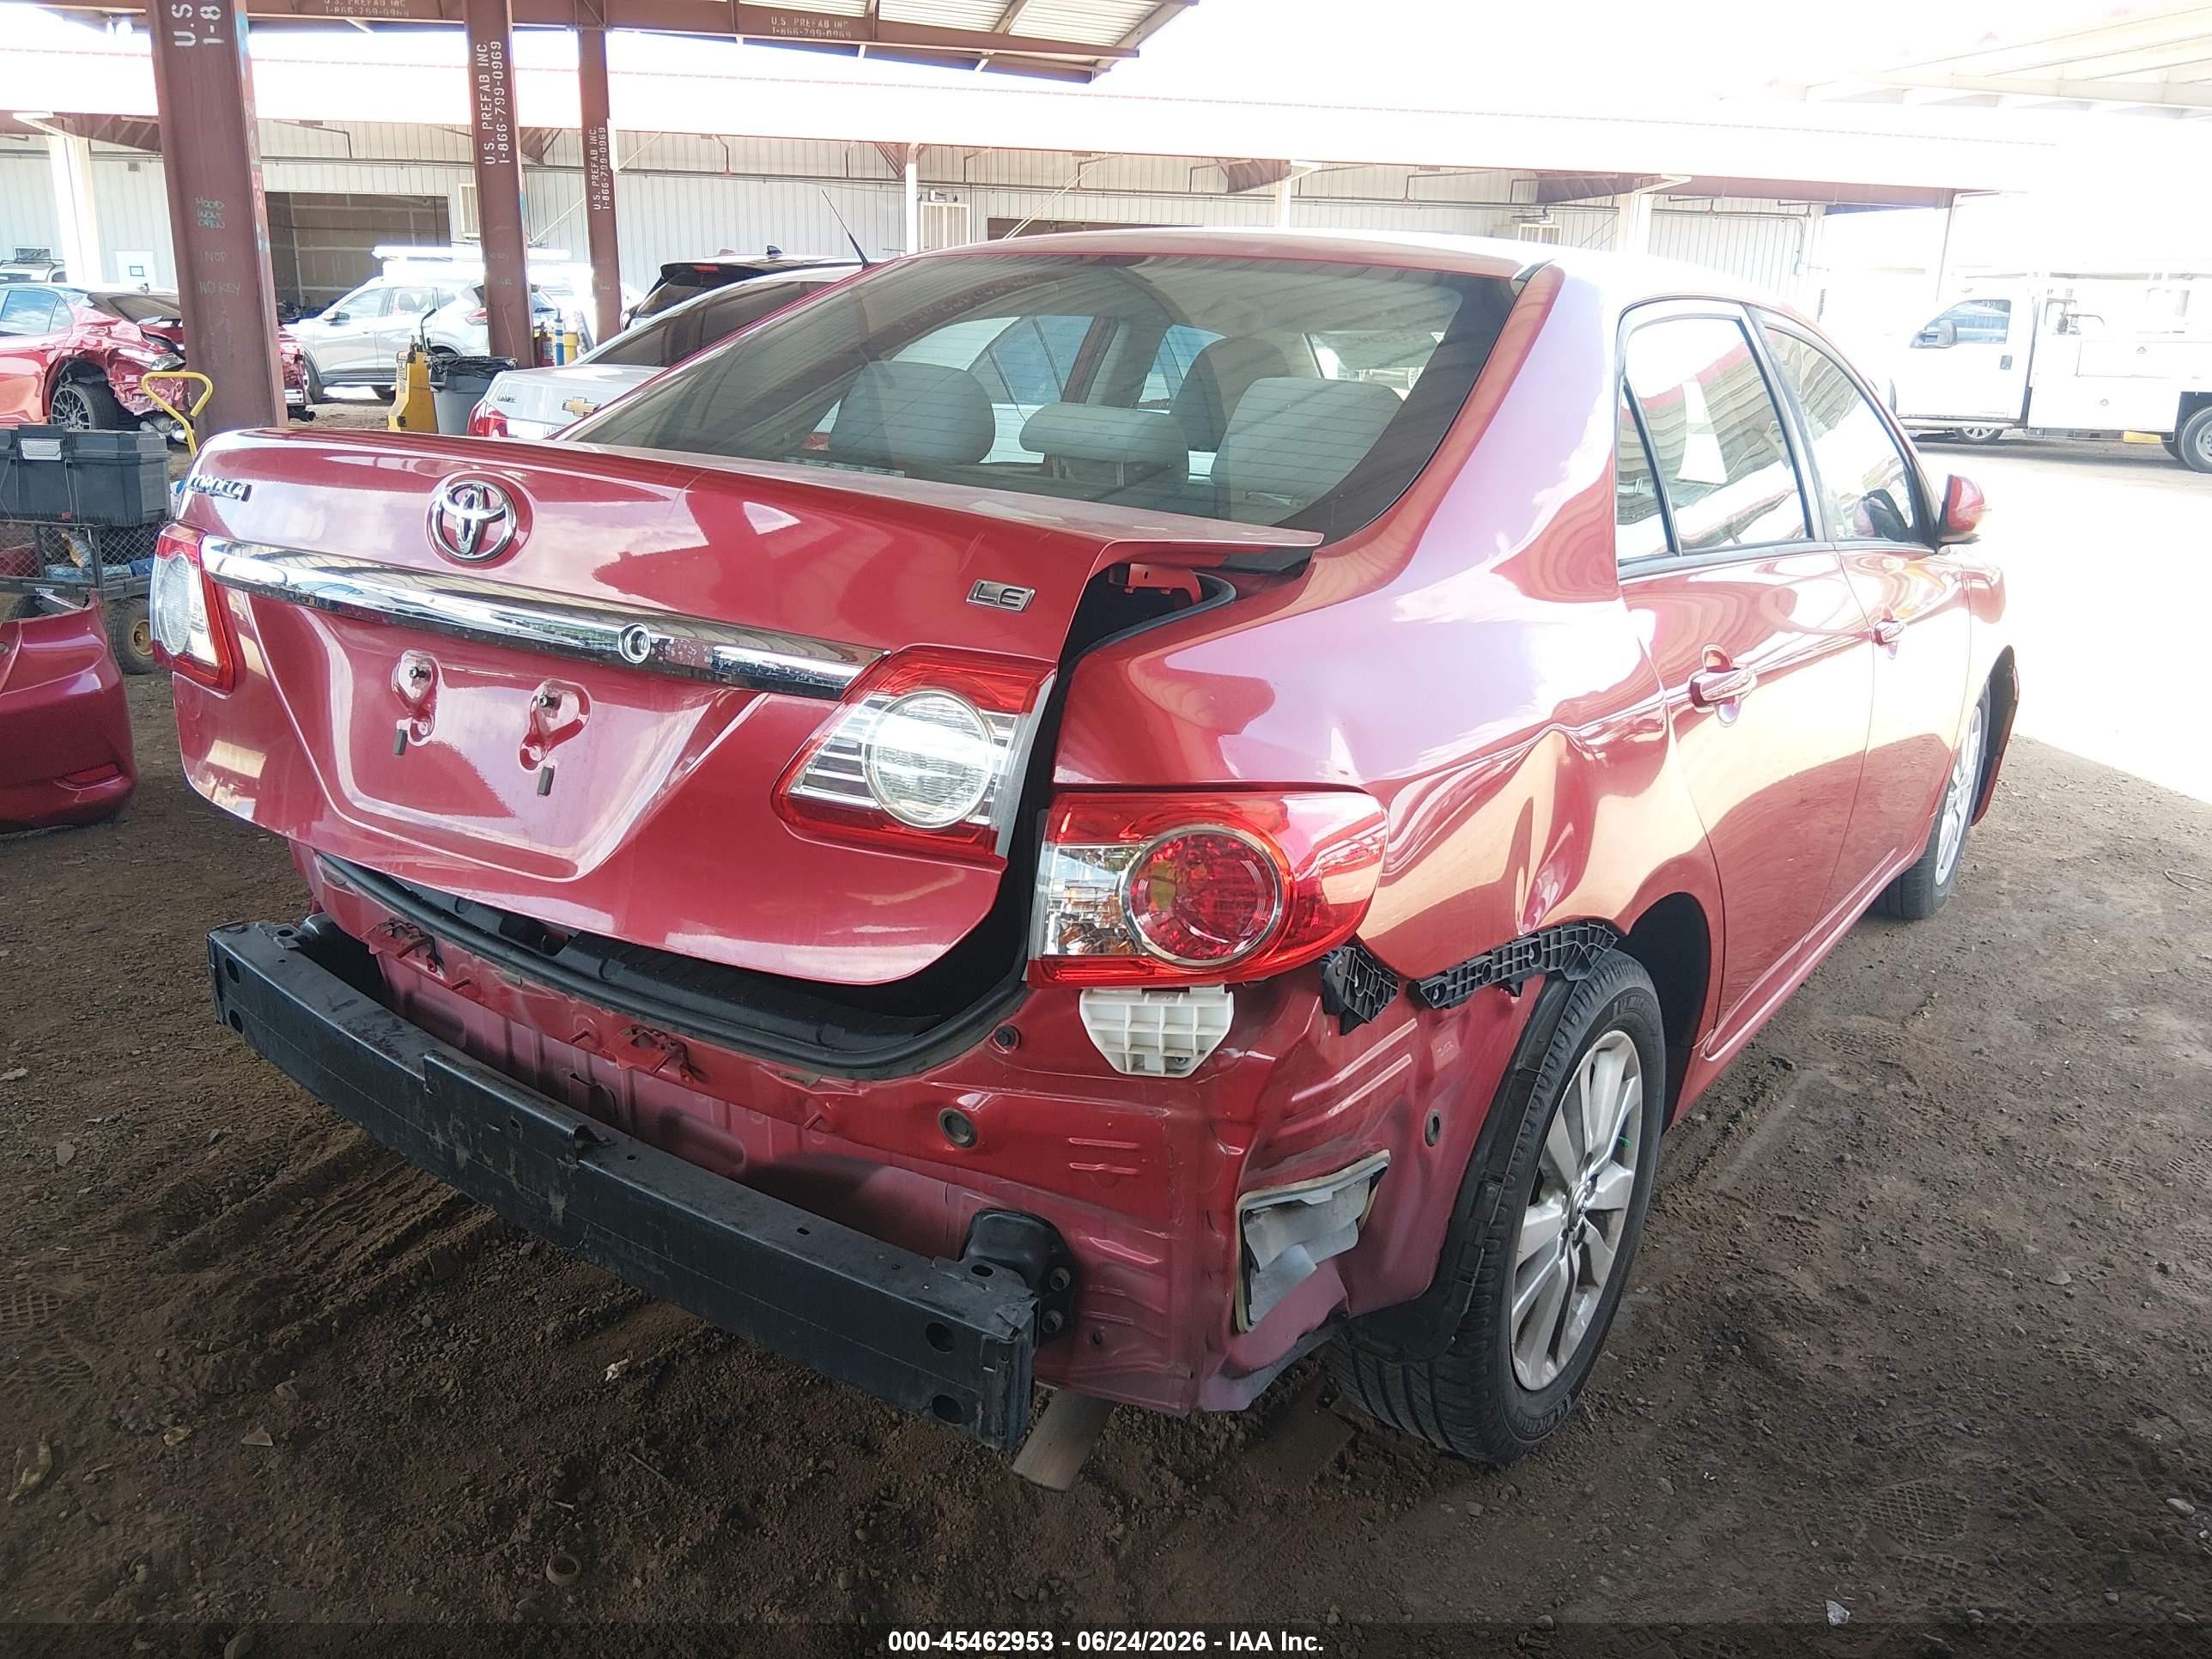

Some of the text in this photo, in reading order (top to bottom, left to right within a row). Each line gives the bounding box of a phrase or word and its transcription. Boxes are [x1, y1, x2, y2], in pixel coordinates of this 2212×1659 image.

[771, 16, 789, 27] U.S.
[793, 17, 830, 28] PREFAB
[476, 40, 496, 165] U.S. PREFAB INC.
[490, 41, 510, 164] 1-866-799-0969
[588, 126, 601, 210] U.S. PREFAB INC.
[598, 127, 611, 210] 1-866-799-0969
[199, 280, 240, 296] NO KEY
[975, 583, 1026, 607] LE
